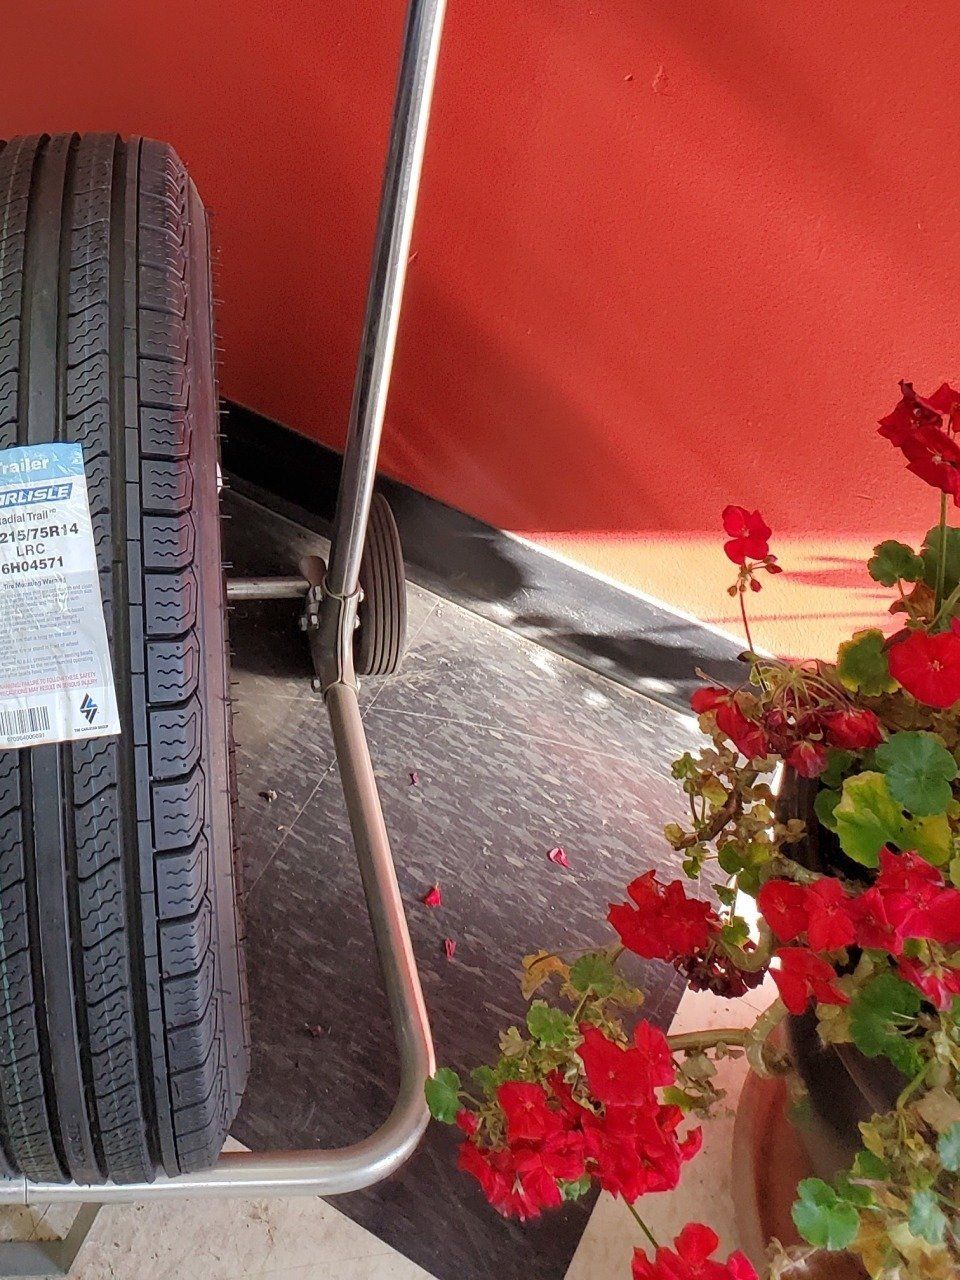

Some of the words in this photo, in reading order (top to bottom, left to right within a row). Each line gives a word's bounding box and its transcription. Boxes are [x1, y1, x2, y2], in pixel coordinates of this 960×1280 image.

[27, 510, 48, 521] Trail
[16, 543, 45, 556] LRC
[2, 556, 63, 574] 6H04571
